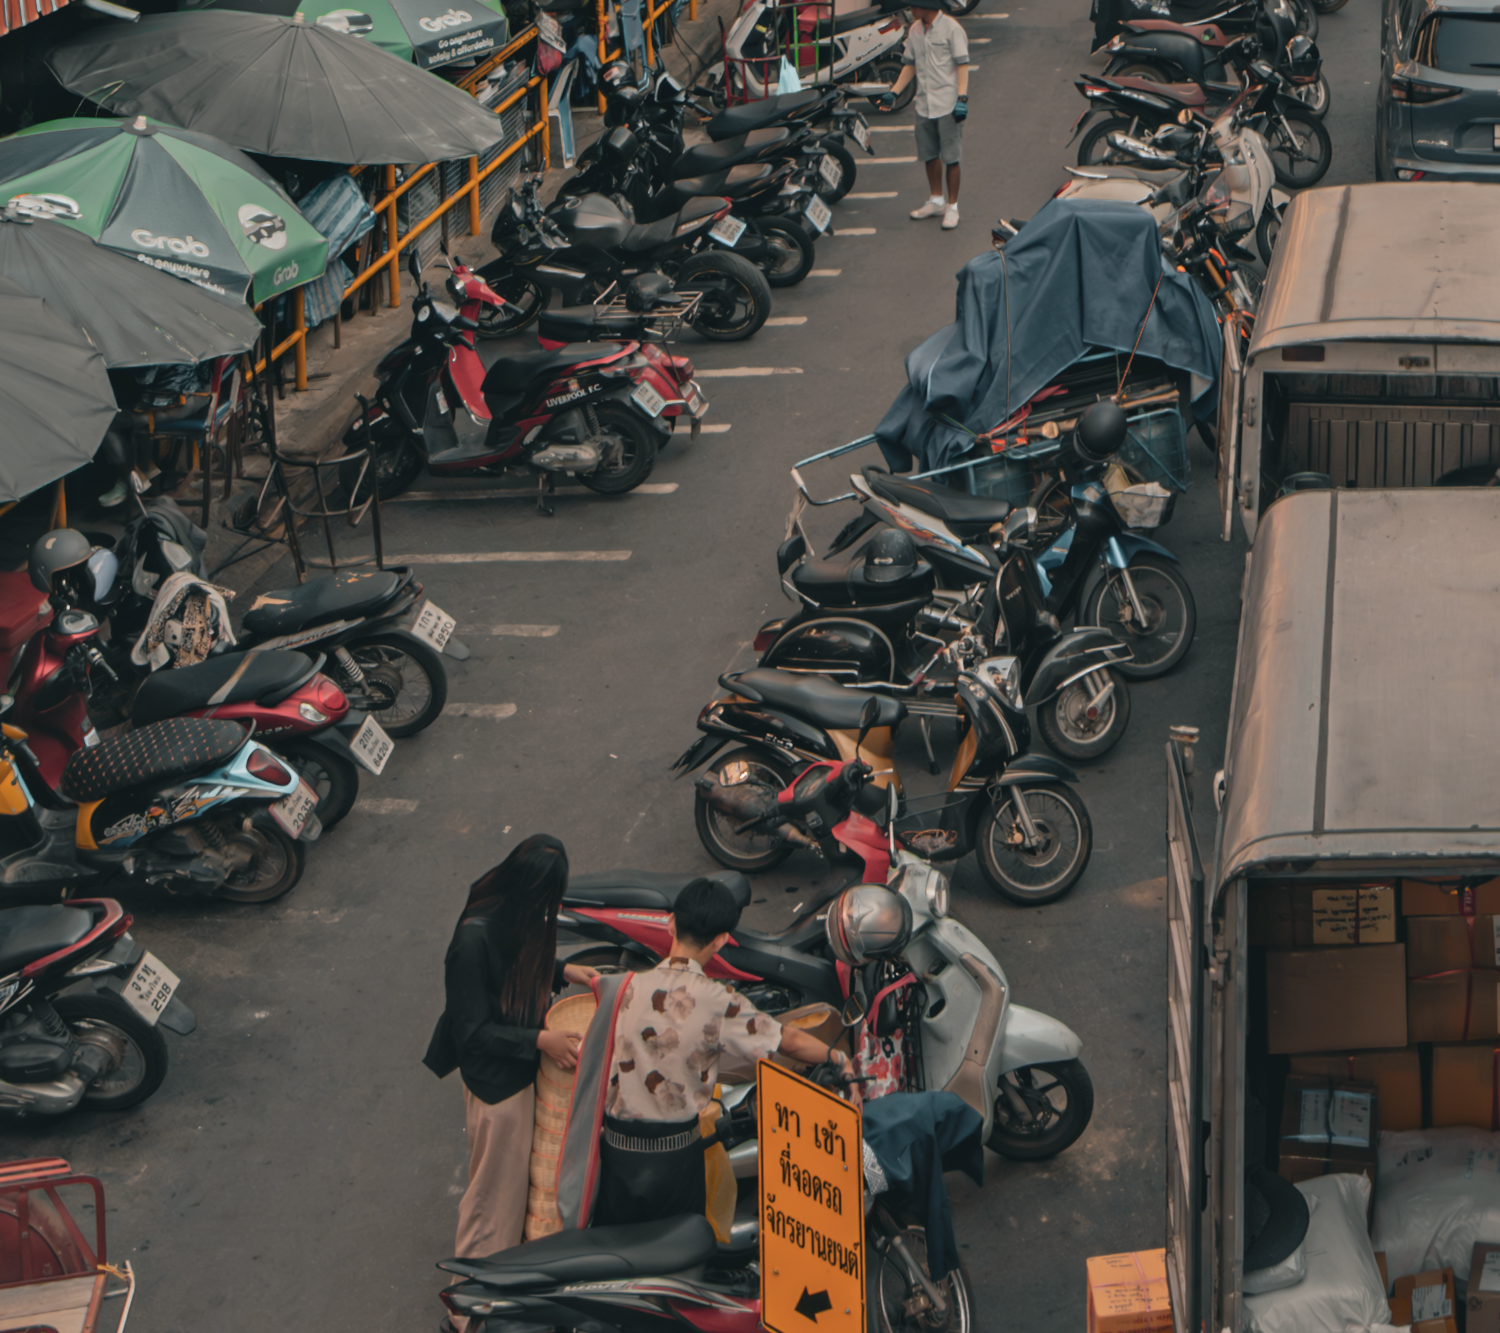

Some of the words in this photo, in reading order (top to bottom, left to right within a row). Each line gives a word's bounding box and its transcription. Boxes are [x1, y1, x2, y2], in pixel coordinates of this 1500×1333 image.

[419, 8, 473, 32] Grab
[428, 50, 449, 64] safely
[455, 37, 494, 58] affordably
[438, 37, 449, 49] Go
[449, 29, 483, 48] anywhere
[130, 228, 210, 258] Grab
[273, 259, 299, 285] Grab
[546, 388, 588, 408] LIVERPOOL
[435, 621, 453, 648] 8950
[372, 741, 390, 767] 6420
[293, 797, 315, 831] 2035
[150, 982, 172, 1012] 298
[814, 1119, 846, 1163] เข้า
[780, 1142, 842, 1216] ที่จอดรถ
[765, 1192, 860, 1281] จักรยานยนต์
